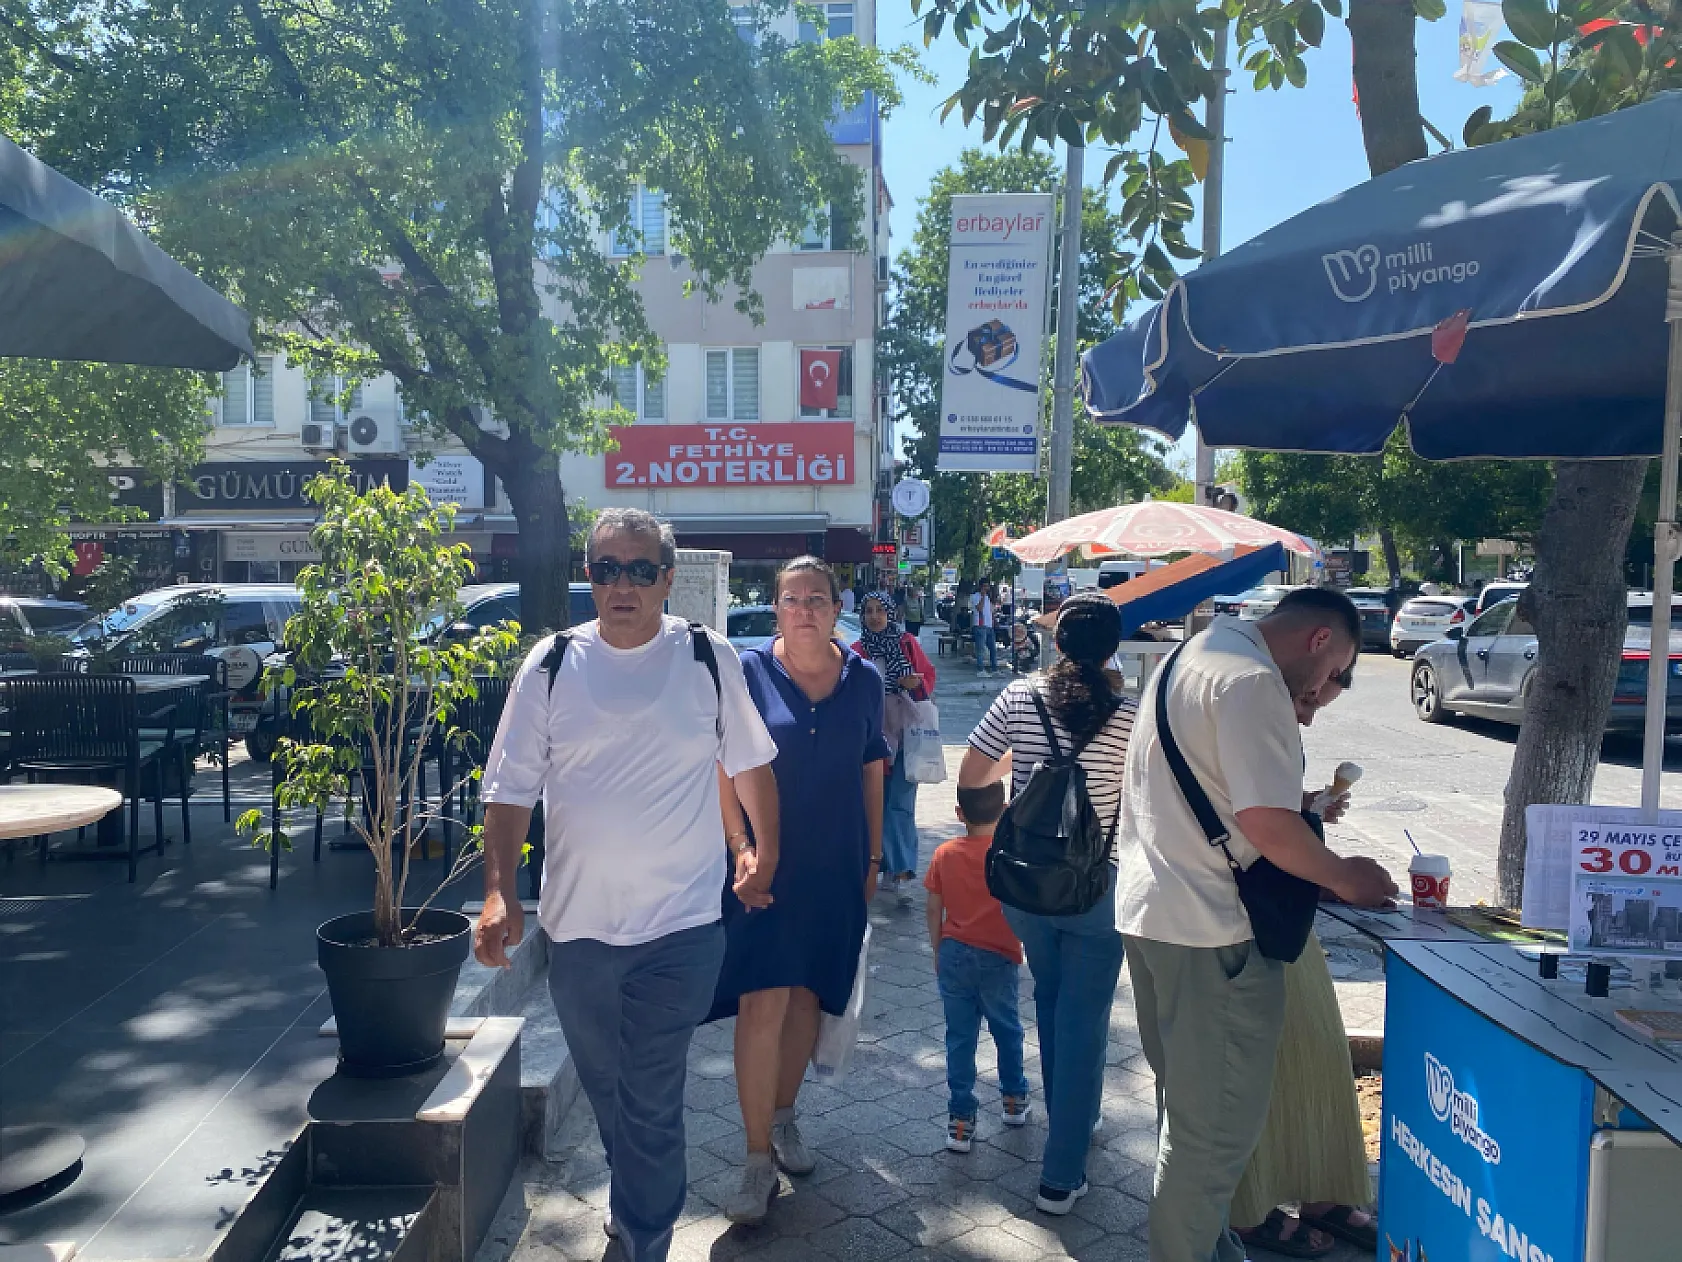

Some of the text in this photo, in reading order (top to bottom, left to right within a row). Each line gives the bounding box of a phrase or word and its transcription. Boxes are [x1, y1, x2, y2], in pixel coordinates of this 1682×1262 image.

[956, 212, 1044, 240] erbaylar
[1385, 241, 1433, 269] milli
[1388, 260, 1480, 295] piyango
[704, 427, 757, 441] T.C.
[669, 441, 794, 458] FETHİYE
[1579, 829, 1600, 842] 29
[1604, 831, 1657, 846] MAYIS
[1579, 846, 1652, 875] 30
[1453, 1091, 1477, 1121] milli
[1453, 1112, 1500, 1161] piyango
